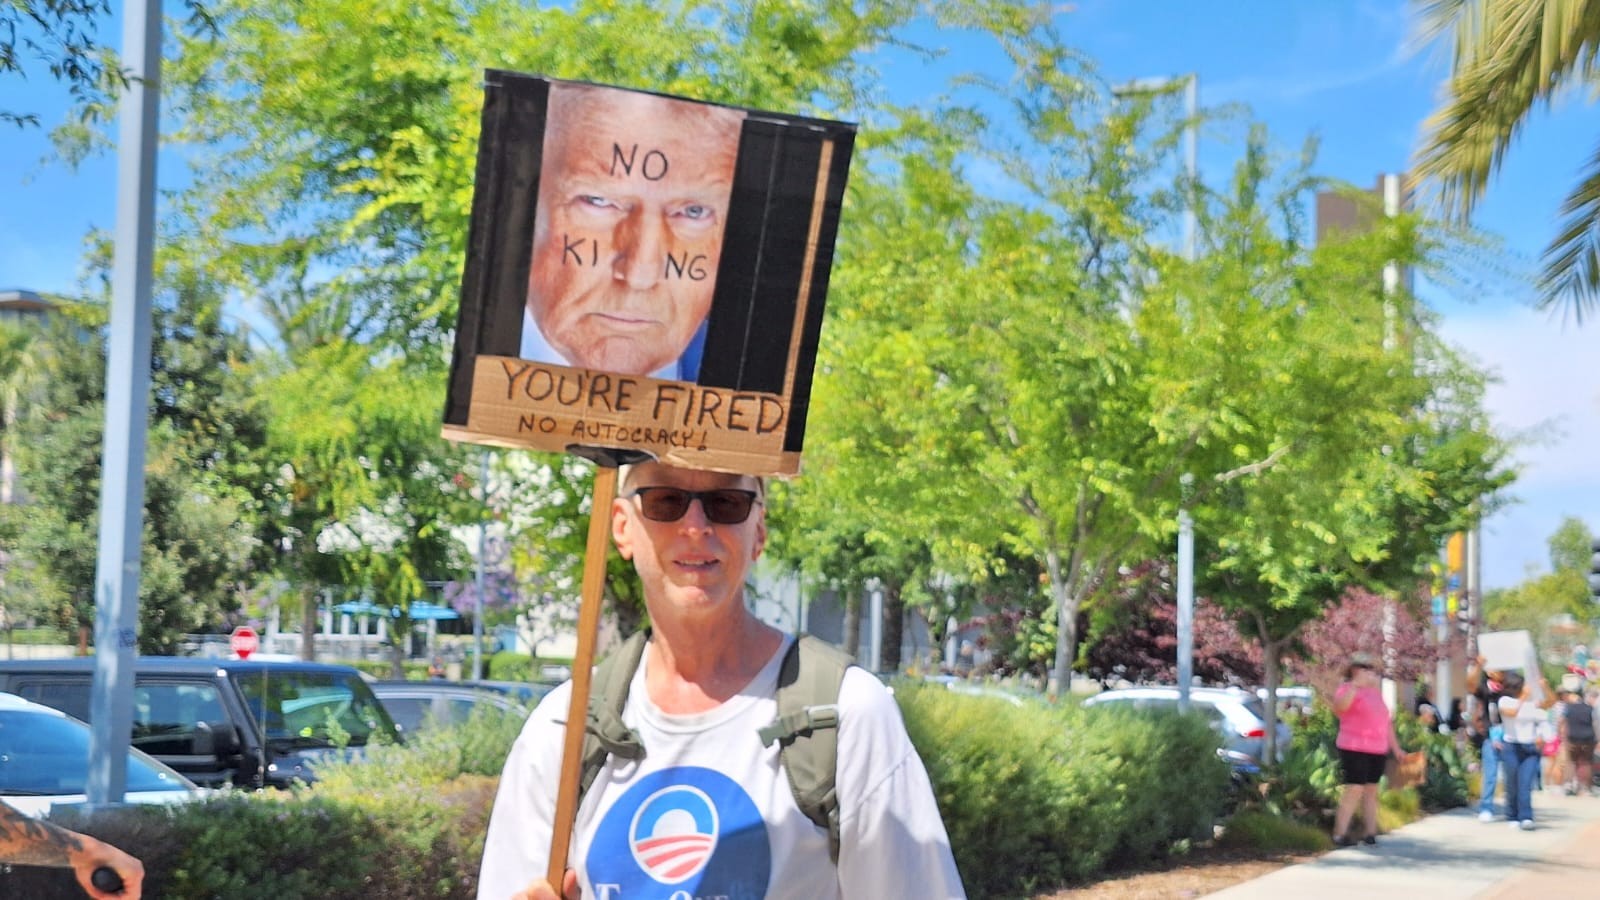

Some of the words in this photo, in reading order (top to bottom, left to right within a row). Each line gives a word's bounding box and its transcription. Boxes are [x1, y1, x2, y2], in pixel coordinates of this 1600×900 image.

[609, 142, 669, 182] NO
[501, 361, 638, 413] YOU'RE
[652, 383, 785, 435] FIRED
[517, 414, 557, 434] NO
[571, 419, 708, 451] AUTOCRACY!
